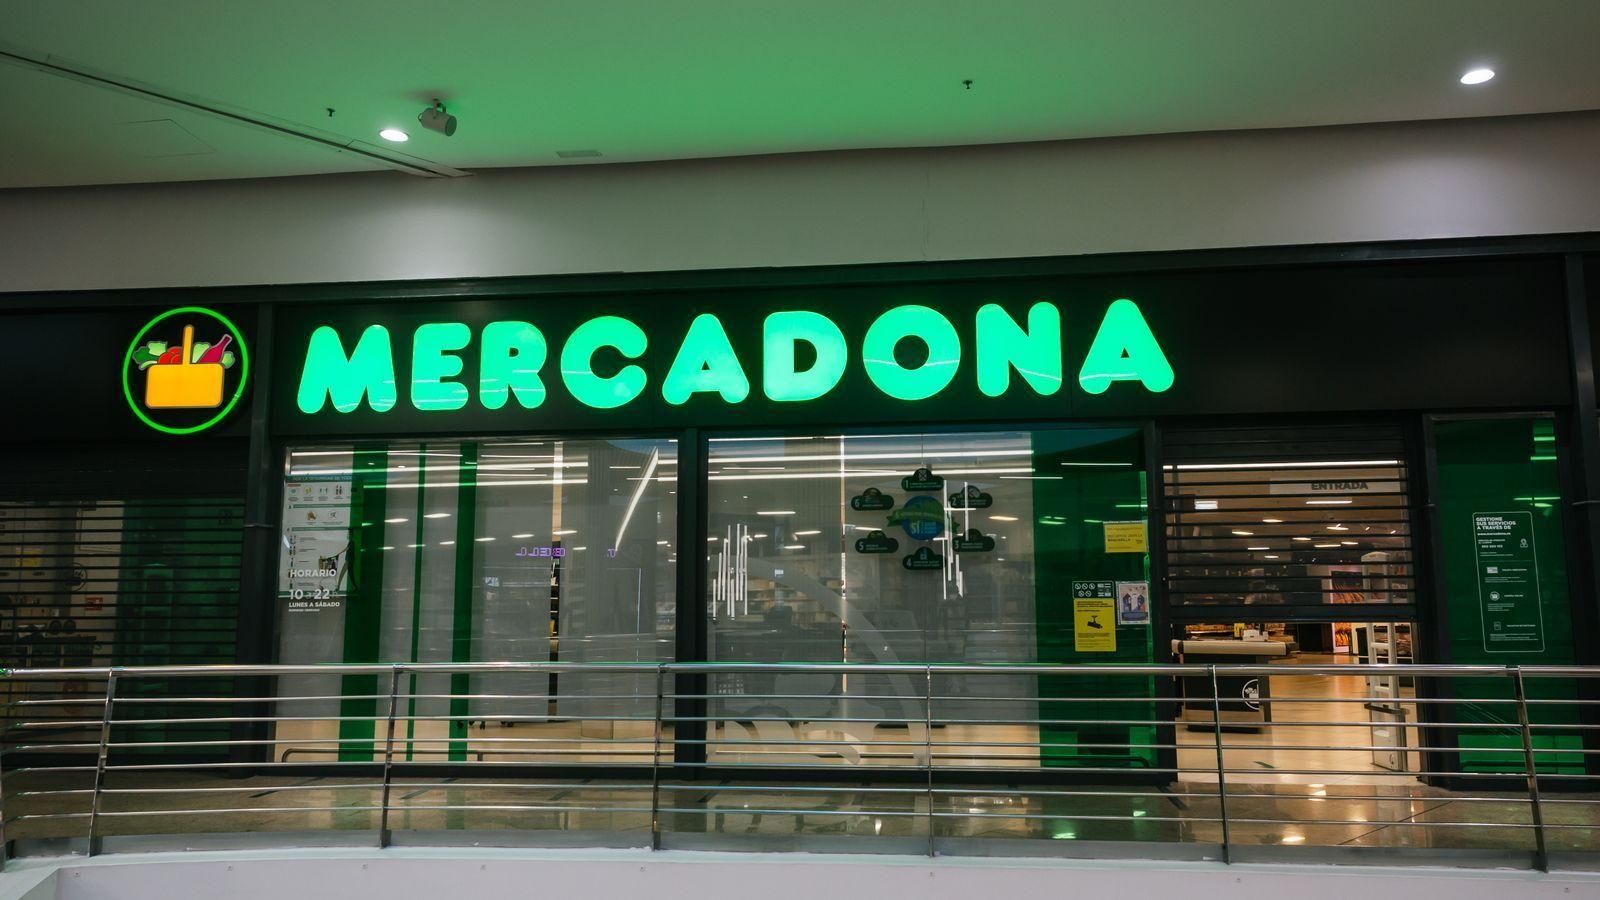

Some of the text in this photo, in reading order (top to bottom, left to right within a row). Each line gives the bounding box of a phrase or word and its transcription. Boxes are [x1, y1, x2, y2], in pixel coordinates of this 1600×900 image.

[297, 299, 1175, 413] MERCADONA
[1311, 482, 1369, 491] ENTRADA
[951, 497, 958, 505] 2
[859, 541, 865, 549] 5
[954, 540, 960, 549] 3
[906, 558, 912, 567] 4
[290, 569, 337, 577] HORARIO
[289, 589, 304, 600] 10
[313, 589, 330, 600] 22
